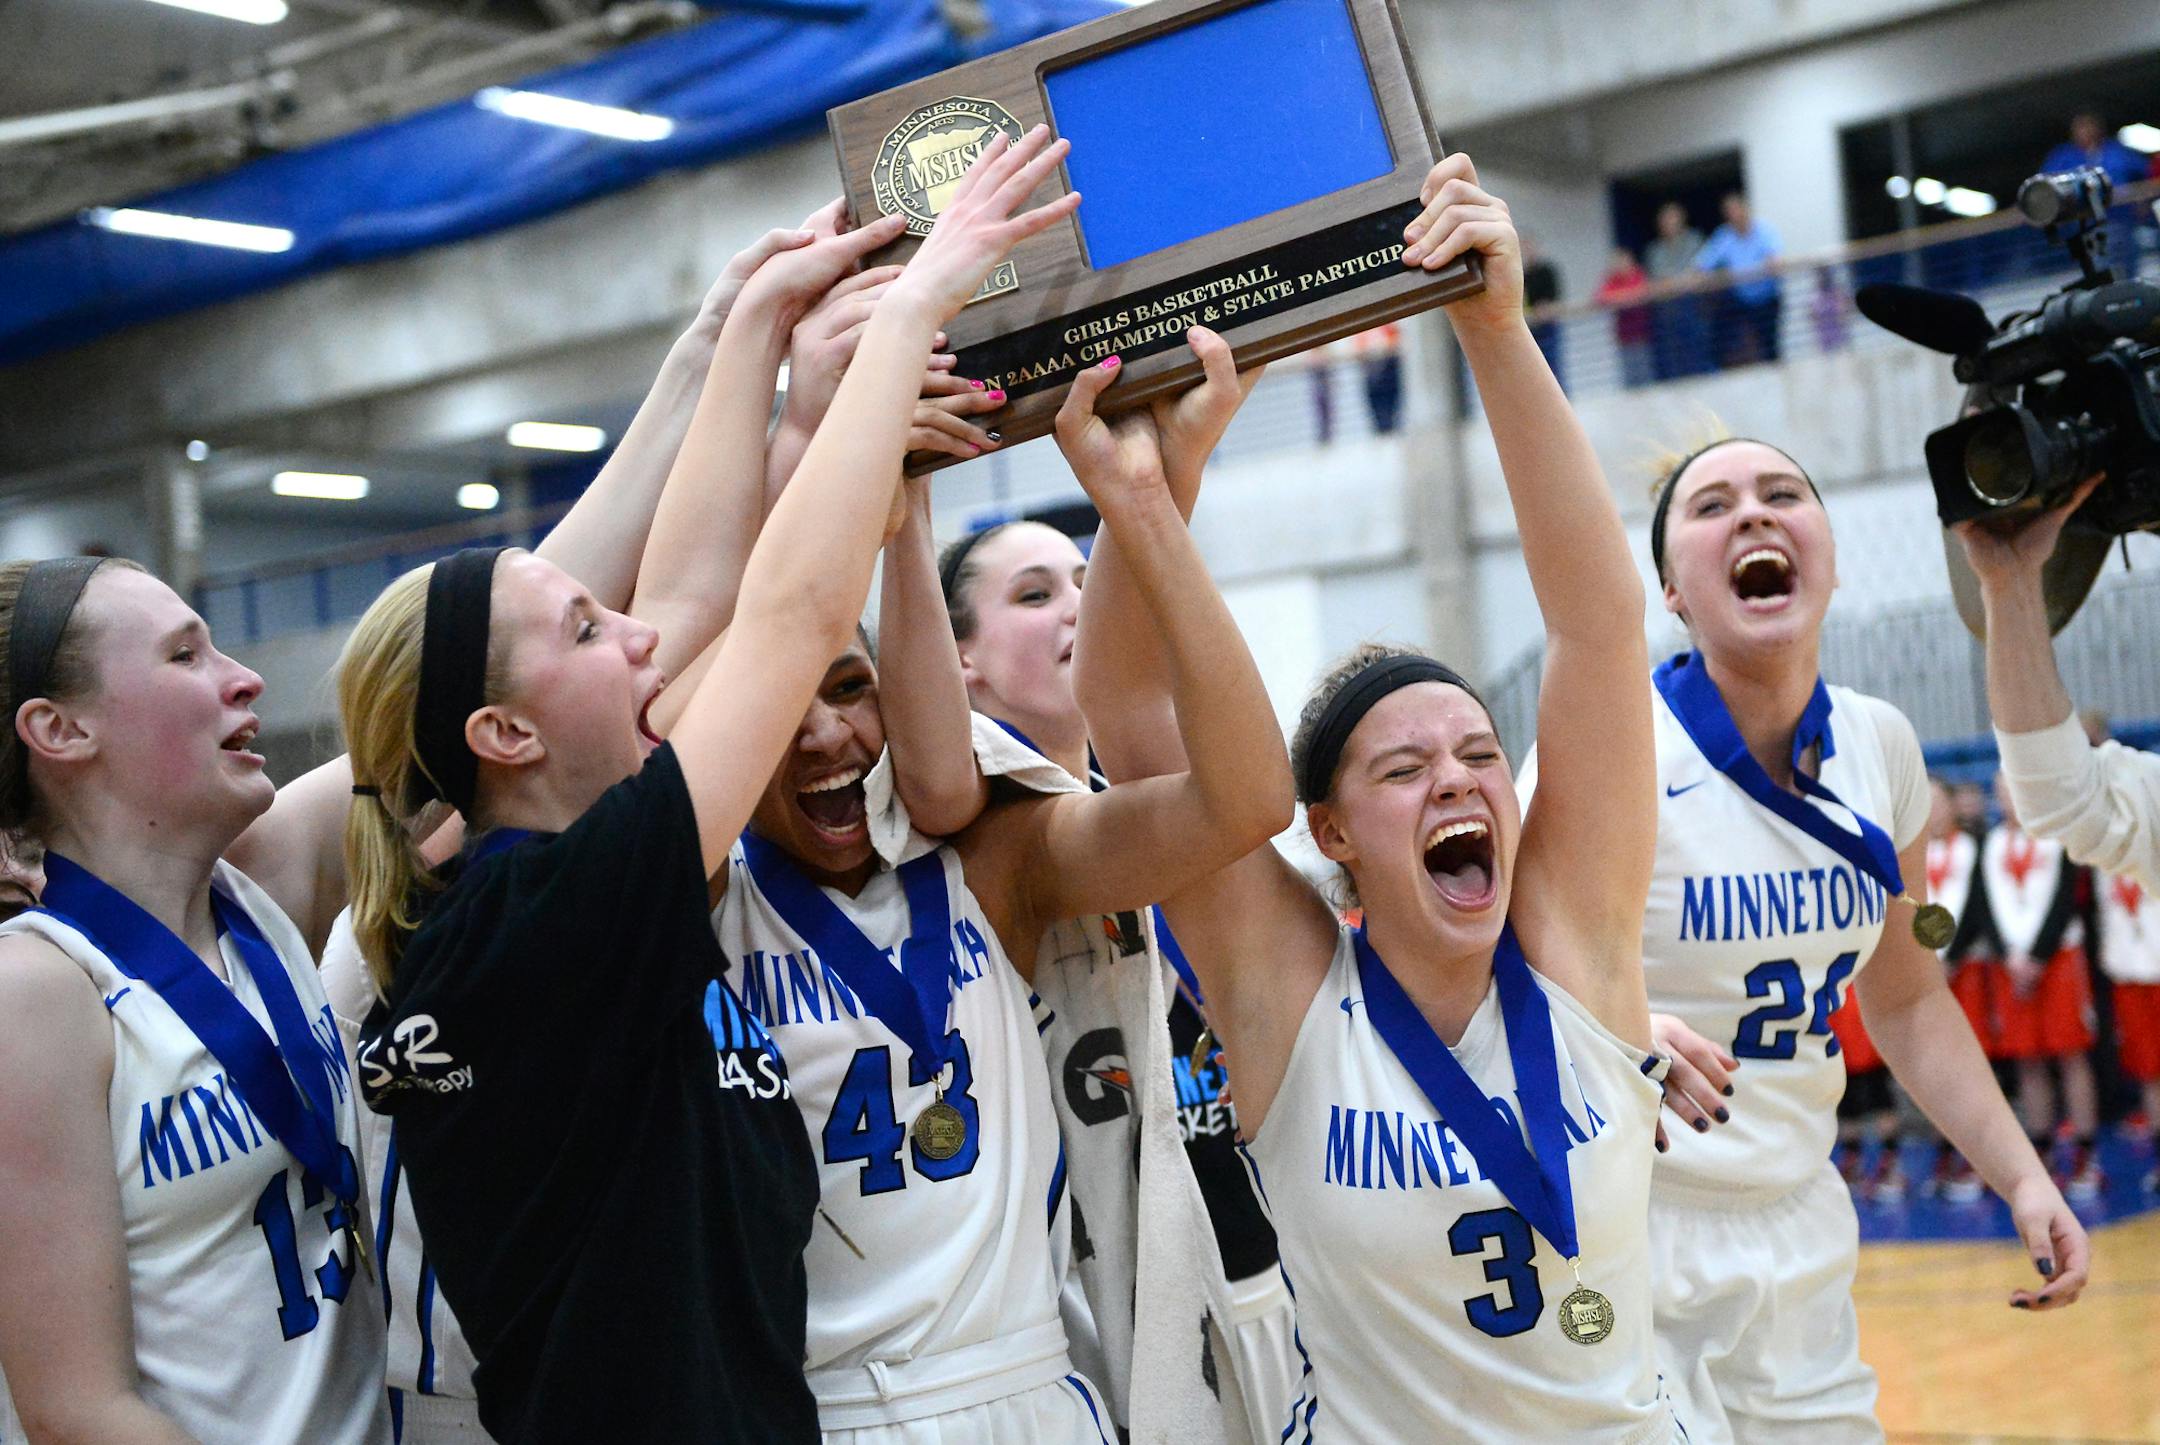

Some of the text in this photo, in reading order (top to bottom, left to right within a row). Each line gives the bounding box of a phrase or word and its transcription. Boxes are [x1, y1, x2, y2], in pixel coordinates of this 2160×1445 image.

[888, 101, 991, 149] MINNESOTA
[927, 116, 955, 131] ARTS
[877, 182, 935, 234] STAT HIG
[893, 153, 923, 210] ACADEMICS
[983, 267, 1011, 294] 16
[1064, 264, 1279, 345] GIRLS BASKETBALL
[1007, 352, 1077, 387] 2AAAA
[1080, 310, 1199, 362] CHAMPION
[1203, 305, 1220, 323] &
[1223, 280, 1295, 316] STATE
[1297, 243, 1404, 291] PARTICIP
[822, 1027, 980, 1198] 43
[1447, 1206, 1545, 1339] 3
[1571, 1308, 1603, 1325] MSHSL
